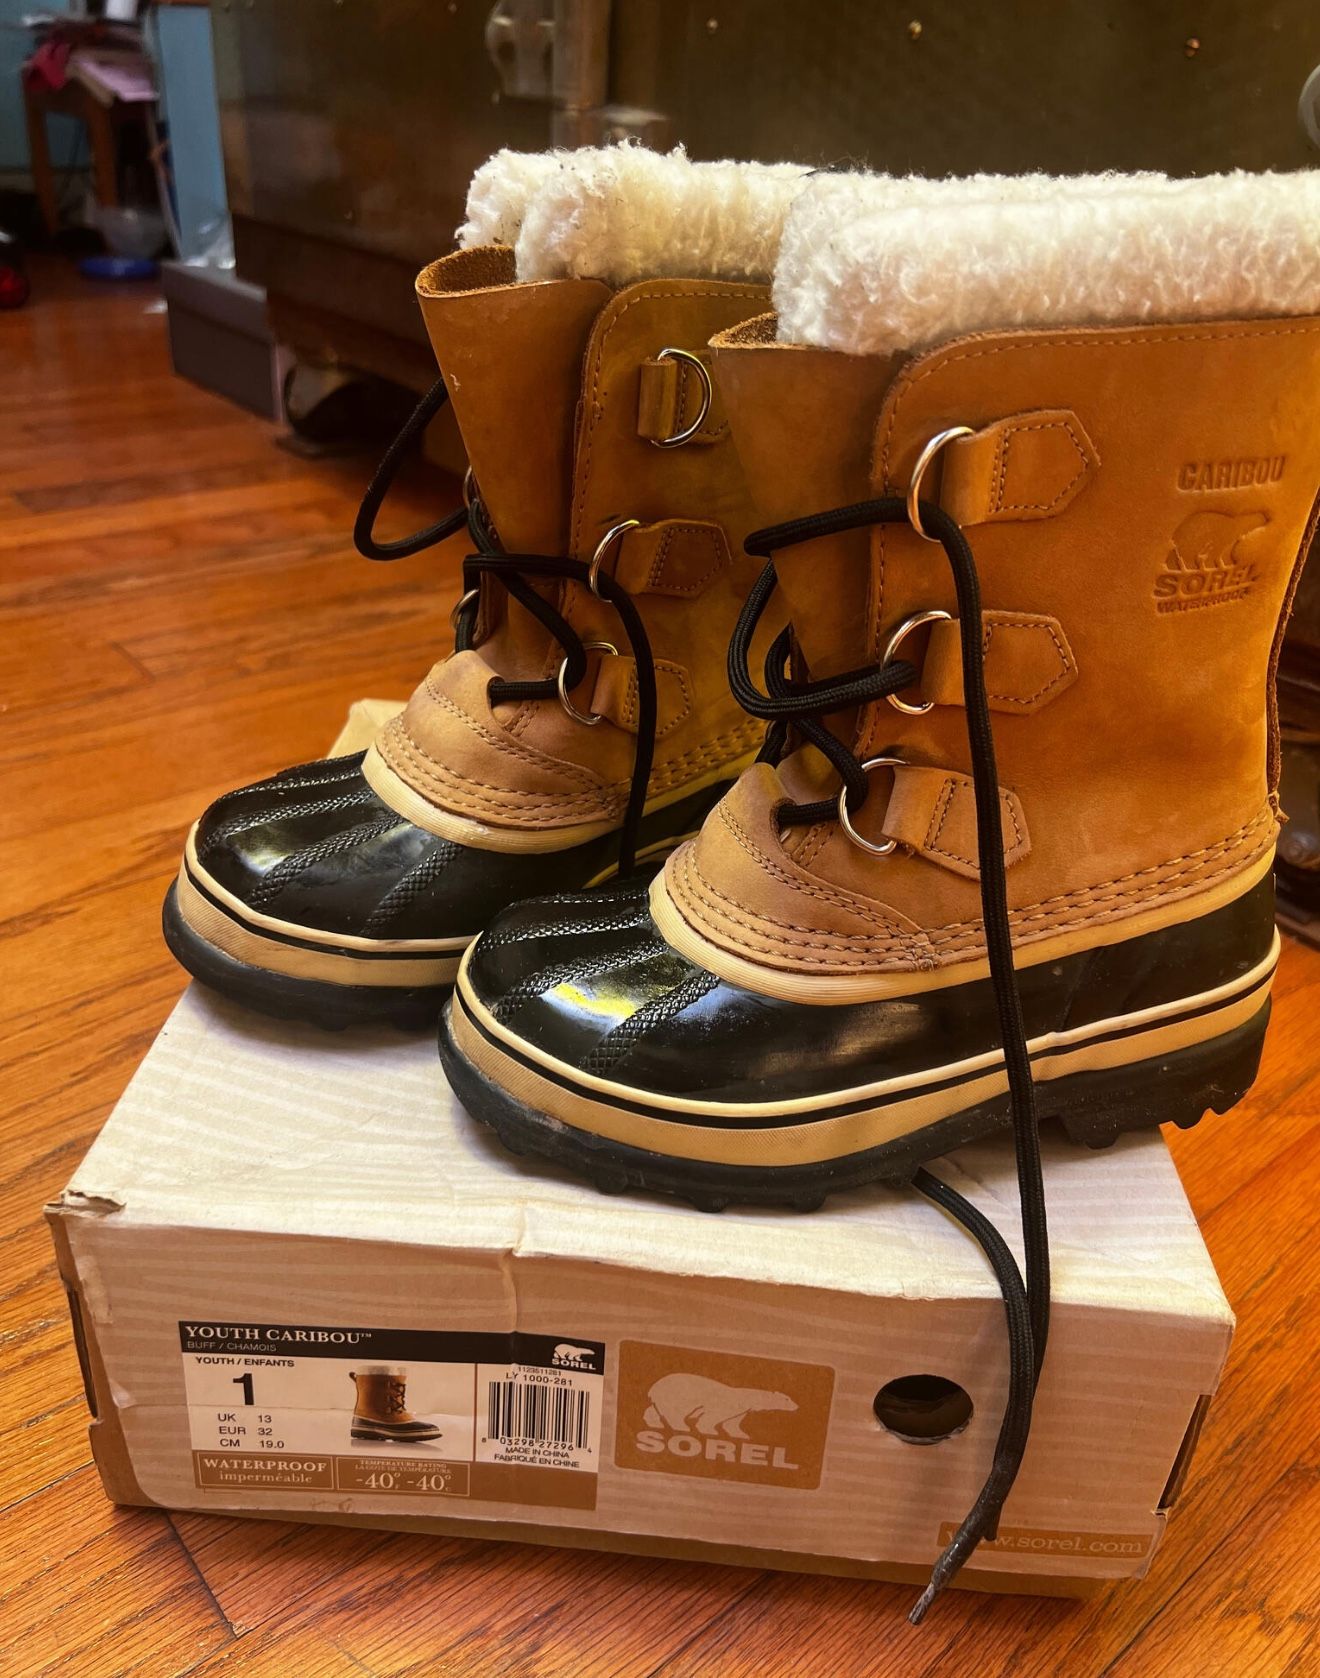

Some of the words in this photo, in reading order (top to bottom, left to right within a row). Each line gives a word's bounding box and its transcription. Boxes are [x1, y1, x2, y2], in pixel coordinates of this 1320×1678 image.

[1176, 455, 1286, 493] CARIBOU
[1153, 564, 1261, 598] SOREL
[185, 1325, 259, 1340] YOUTH
[187, 1341, 216, 1349] BUFF
[227, 1342, 277, 1352] CHAMOIS
[195, 1356, 235, 1365] YOUTH
[244, 1358, 295, 1367] ENFANTS
[551, 1358, 596, 1370] SOREL
[505, 1372, 519, 1380] LY
[523, 1375, 573, 1386] 1000-281
[232, 1373, 254, 1405] 1
[217, 1413, 237, 1422] UK
[258, 1414, 272, 1423] 13
[219, 1426, 246, 1435] EUR
[257, 1427, 273, 1436] 32
[219, 1439, 240, 1448] CM
[260, 1440, 285, 1449] 19.0
[500, 1437, 535, 1448] 03298
[539, 1441, 574, 1451] 27296
[636, 1430, 799, 1470] SOREL
[505, 1447, 531, 1455] MADE
[543, 1450, 570, 1459] CHINA
[203, 1458, 328, 1473] WATERPROOF
[494, 1453, 537, 1464] FABRIQUÉ
[553, 1459, 580, 1468] CHINE
[219, 1471, 313, 1484] imperméable
[946, 1531, 1143, 1553] w.sorel.com
